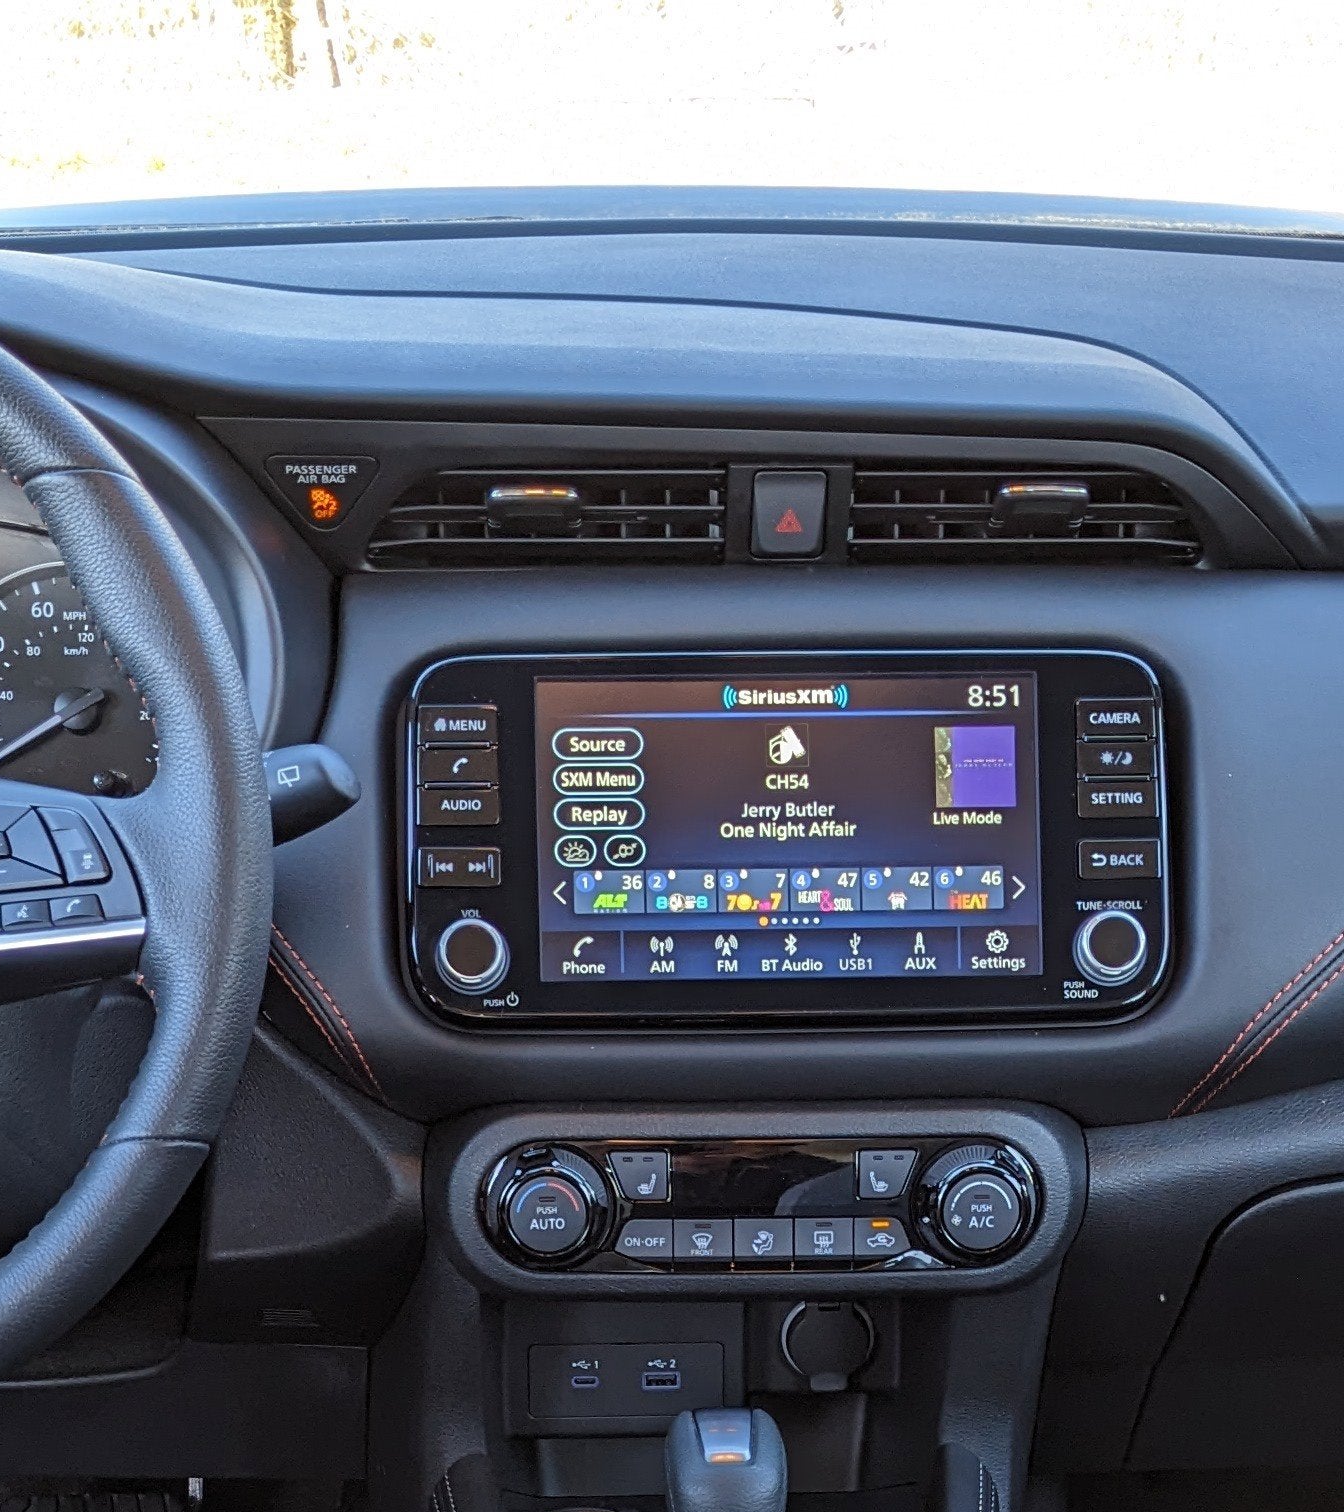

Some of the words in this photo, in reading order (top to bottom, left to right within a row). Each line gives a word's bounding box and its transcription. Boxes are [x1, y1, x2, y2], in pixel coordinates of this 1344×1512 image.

[285, 465, 357, 475] PASSENGER
[297, 475, 317, 484] AIR
[321, 475, 346, 484] BAG
[31, 602, 54, 618] 60
[63, 612, 87, 621] MPH
[78, 633, 94, 643] 120
[26, 646, 41, 656] 80
[63, 646, 89, 656] km/h
[0, 690, 14, 701] 40
[967, 685, 1020, 707] 8:51
[1089, 712, 1141, 724] CAMERA
[449, 719, 487, 731] MENU
[569, 736, 626, 752] Source
[561, 772, 593, 787] SXM
[596, 772, 636, 787] Menu
[765, 774, 809, 790] CH54
[441, 799, 482, 811] AUDIO
[1091, 792, 1143, 805] SETTING
[571, 806, 628, 825] Replay
[741, 803, 781, 821] Jerry
[785, 802, 835, 818] Butler
[933, 812, 960, 825] Live
[963, 811, 1003, 824] Mode
[720, 823, 754, 838] One
[759, 822, 805, 841] Night
[809, 821, 856, 837] Affair
[1109, 854, 1144, 866] BACK
[622, 875, 643, 890] 36
[703, 874, 715, 889] 8
[776, 873, 786, 888] 7
[837, 872, 858, 888] 47
[909, 872, 930, 886] 42
[981, 871, 1001, 886] 46
[798, 891, 822, 903] HEART
[949, 893, 988, 909] HEAT
[461, 909, 481, 918] VOL
[562, 961, 606, 974] Phone
[650, 961, 675, 973] AM
[717, 960, 738, 972] FM
[761, 959, 779, 971] BT
[782, 958, 823, 971] Audio
[839, 958, 873, 970] USB1
[905, 957, 937, 970] AUX
[971, 956, 1026, 971] Settings
[1064, 989, 1099, 999] SOUND
[483, 999, 505, 1007] PUSH
[536, 1206, 558, 1214] PUSH
[971, 1204, 992, 1212] PUSH
[530, 1218, 565, 1230] AUTO
[968, 1216, 995, 1229] A/C
